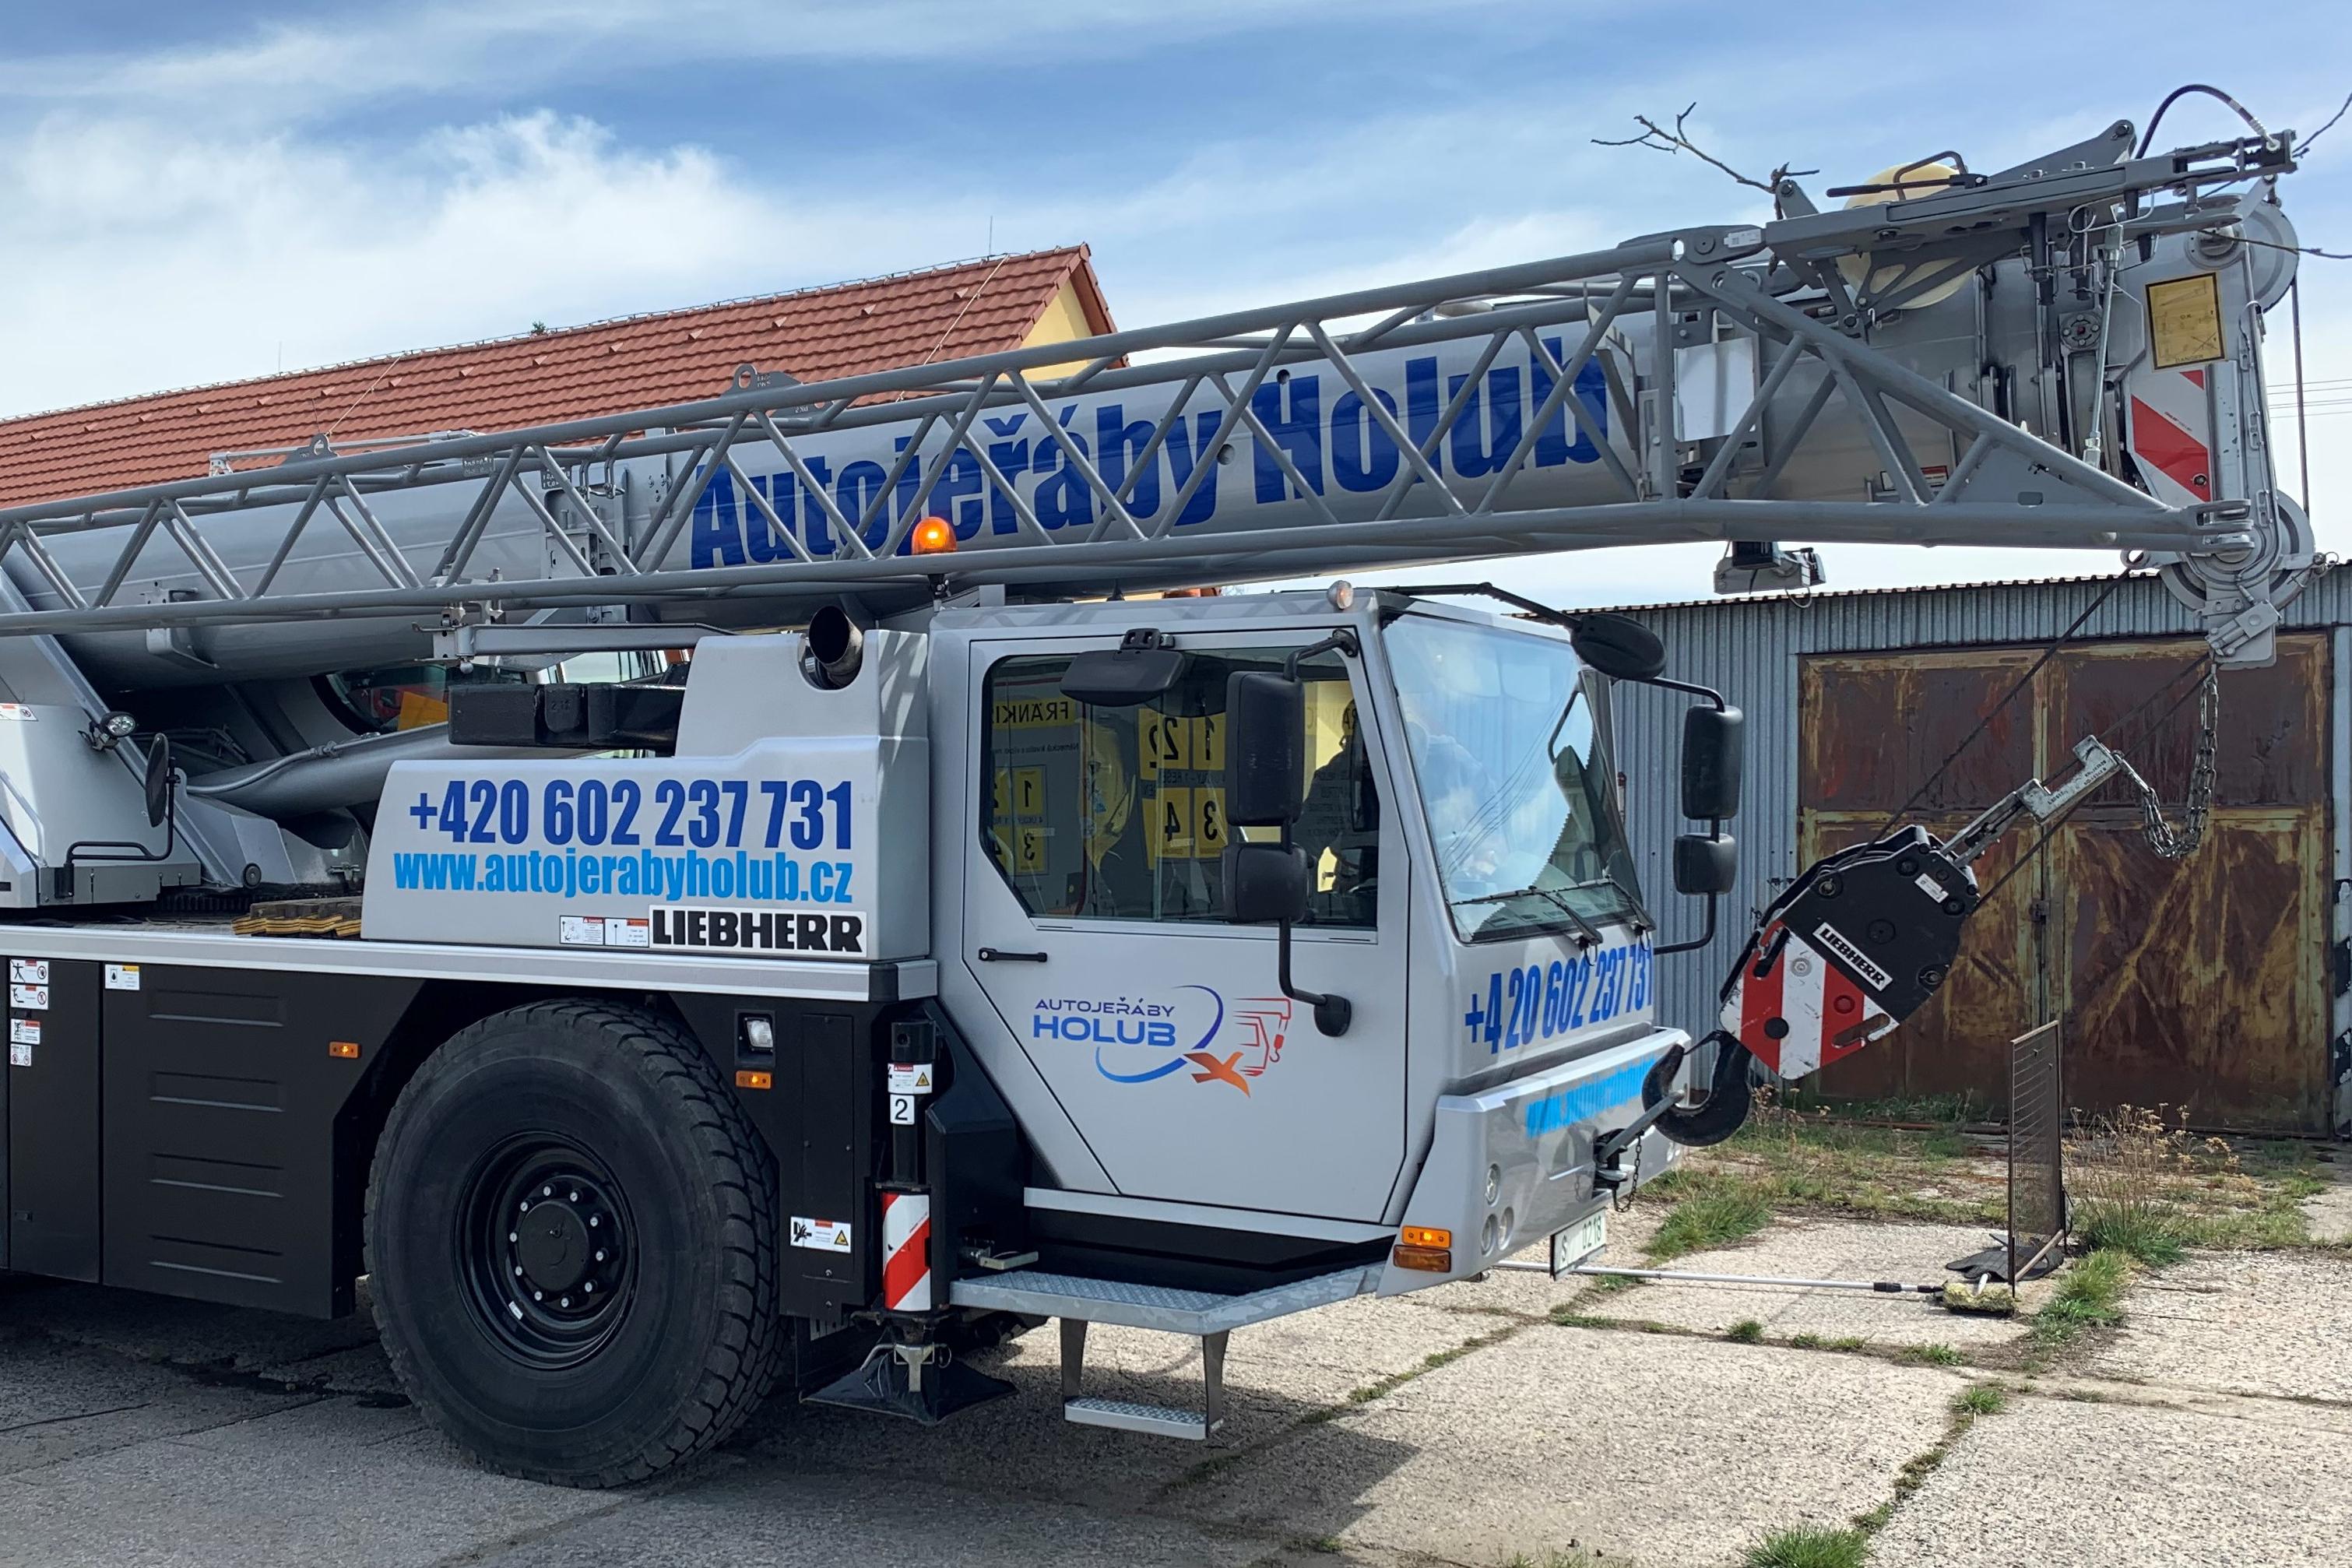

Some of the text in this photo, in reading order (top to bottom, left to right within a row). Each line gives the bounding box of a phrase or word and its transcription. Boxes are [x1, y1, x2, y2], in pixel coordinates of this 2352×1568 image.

[691, 336, 1608, 570] Autojeřáby Holub
[410, 779, 853, 850] +420 602 237 731
[394, 848, 853, 904] www.autojerabyholub.cz
[652, 909, 863, 952] LIEBHERR
[1820, 928, 1886, 986] LIEBHERR
[1035, 997, 1175, 1017] AUTOJEŘÁBY
[1465, 939, 1652, 1054] +420 602 237 731
[1033, 1015, 1176, 1047] HOLUB
[895, 1098, 909, 1121] 2
